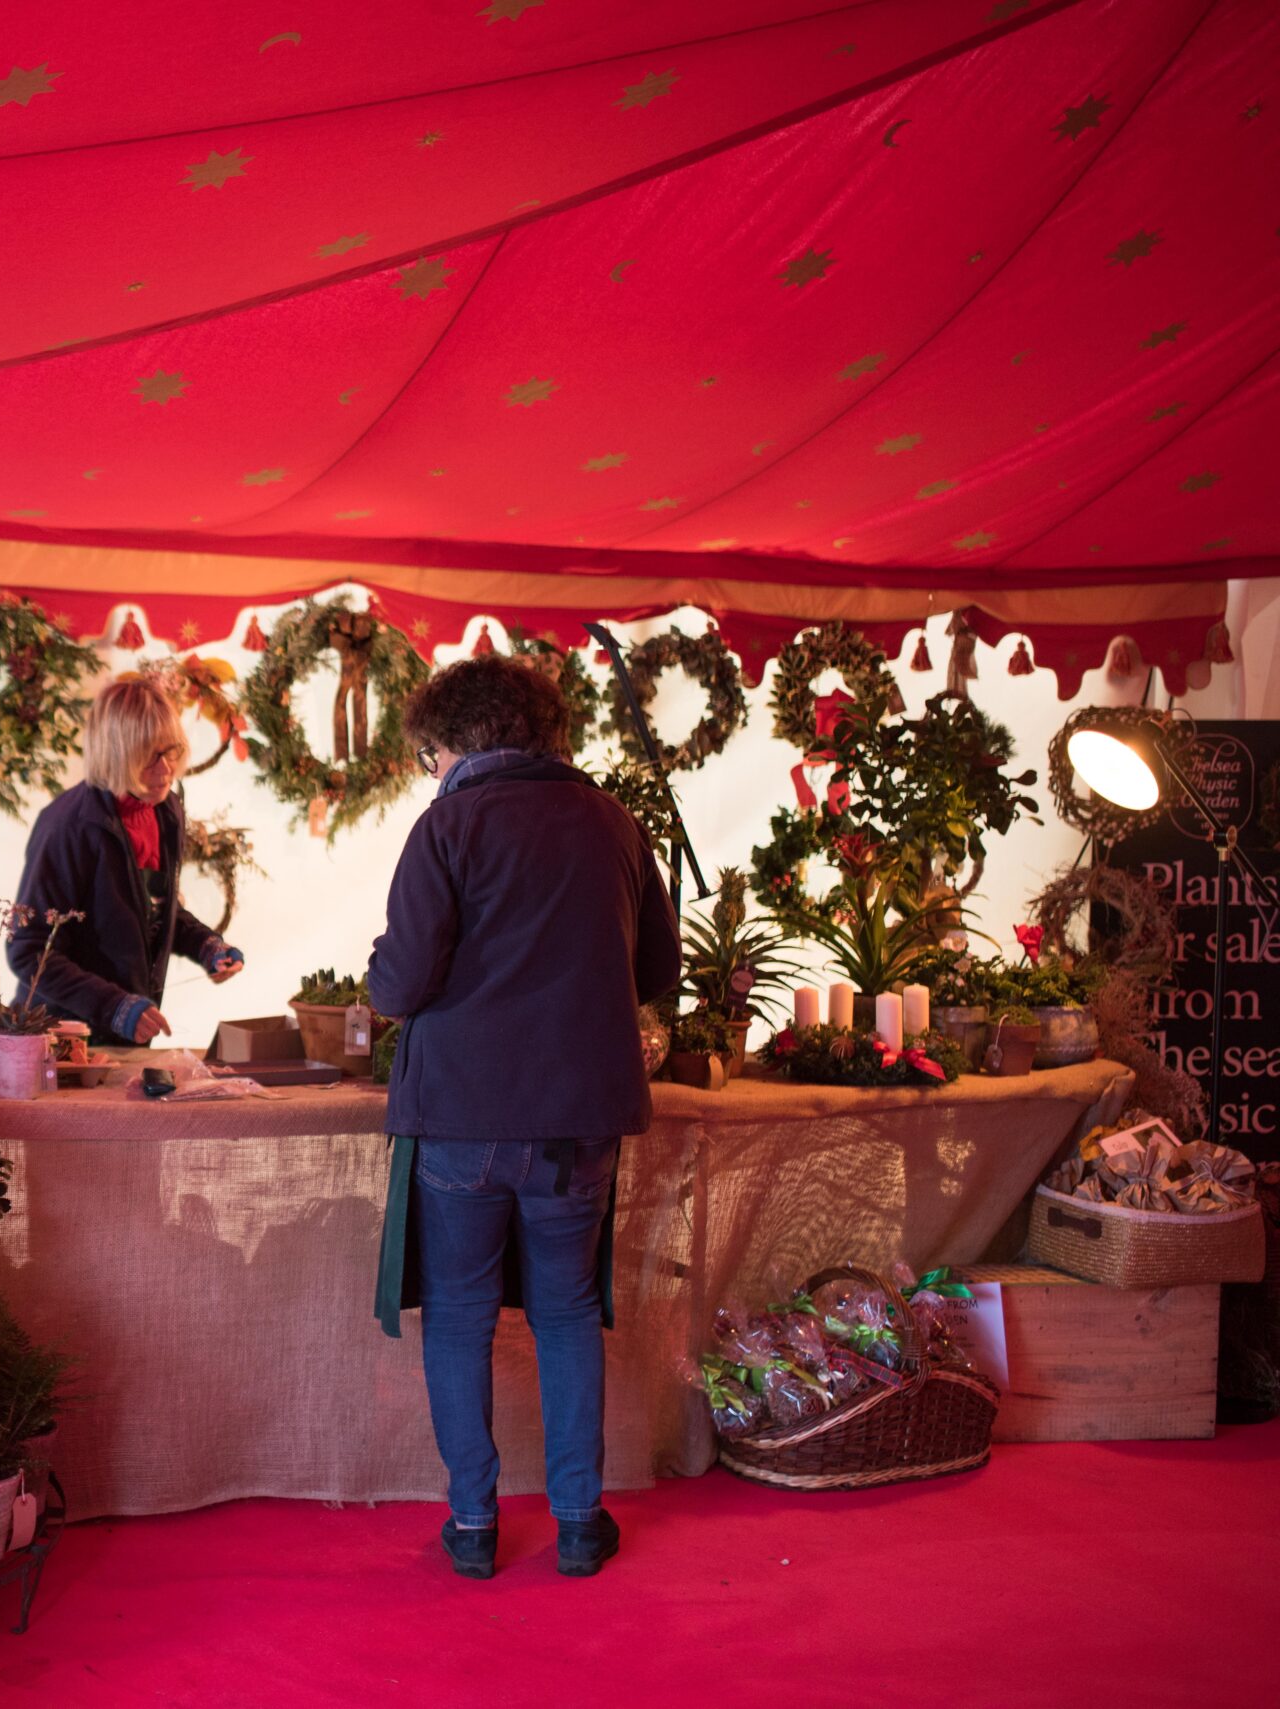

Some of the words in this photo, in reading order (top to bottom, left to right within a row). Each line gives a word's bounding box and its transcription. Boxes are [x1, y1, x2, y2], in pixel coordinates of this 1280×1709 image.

[1181, 792, 1240, 809] Grden
[1142, 860, 1278, 906] Plants
[1205, 918, 1280, 963] sale
[1150, 1031, 1280, 1077] hesea
[947, 1299, 979, 1310] FROM
